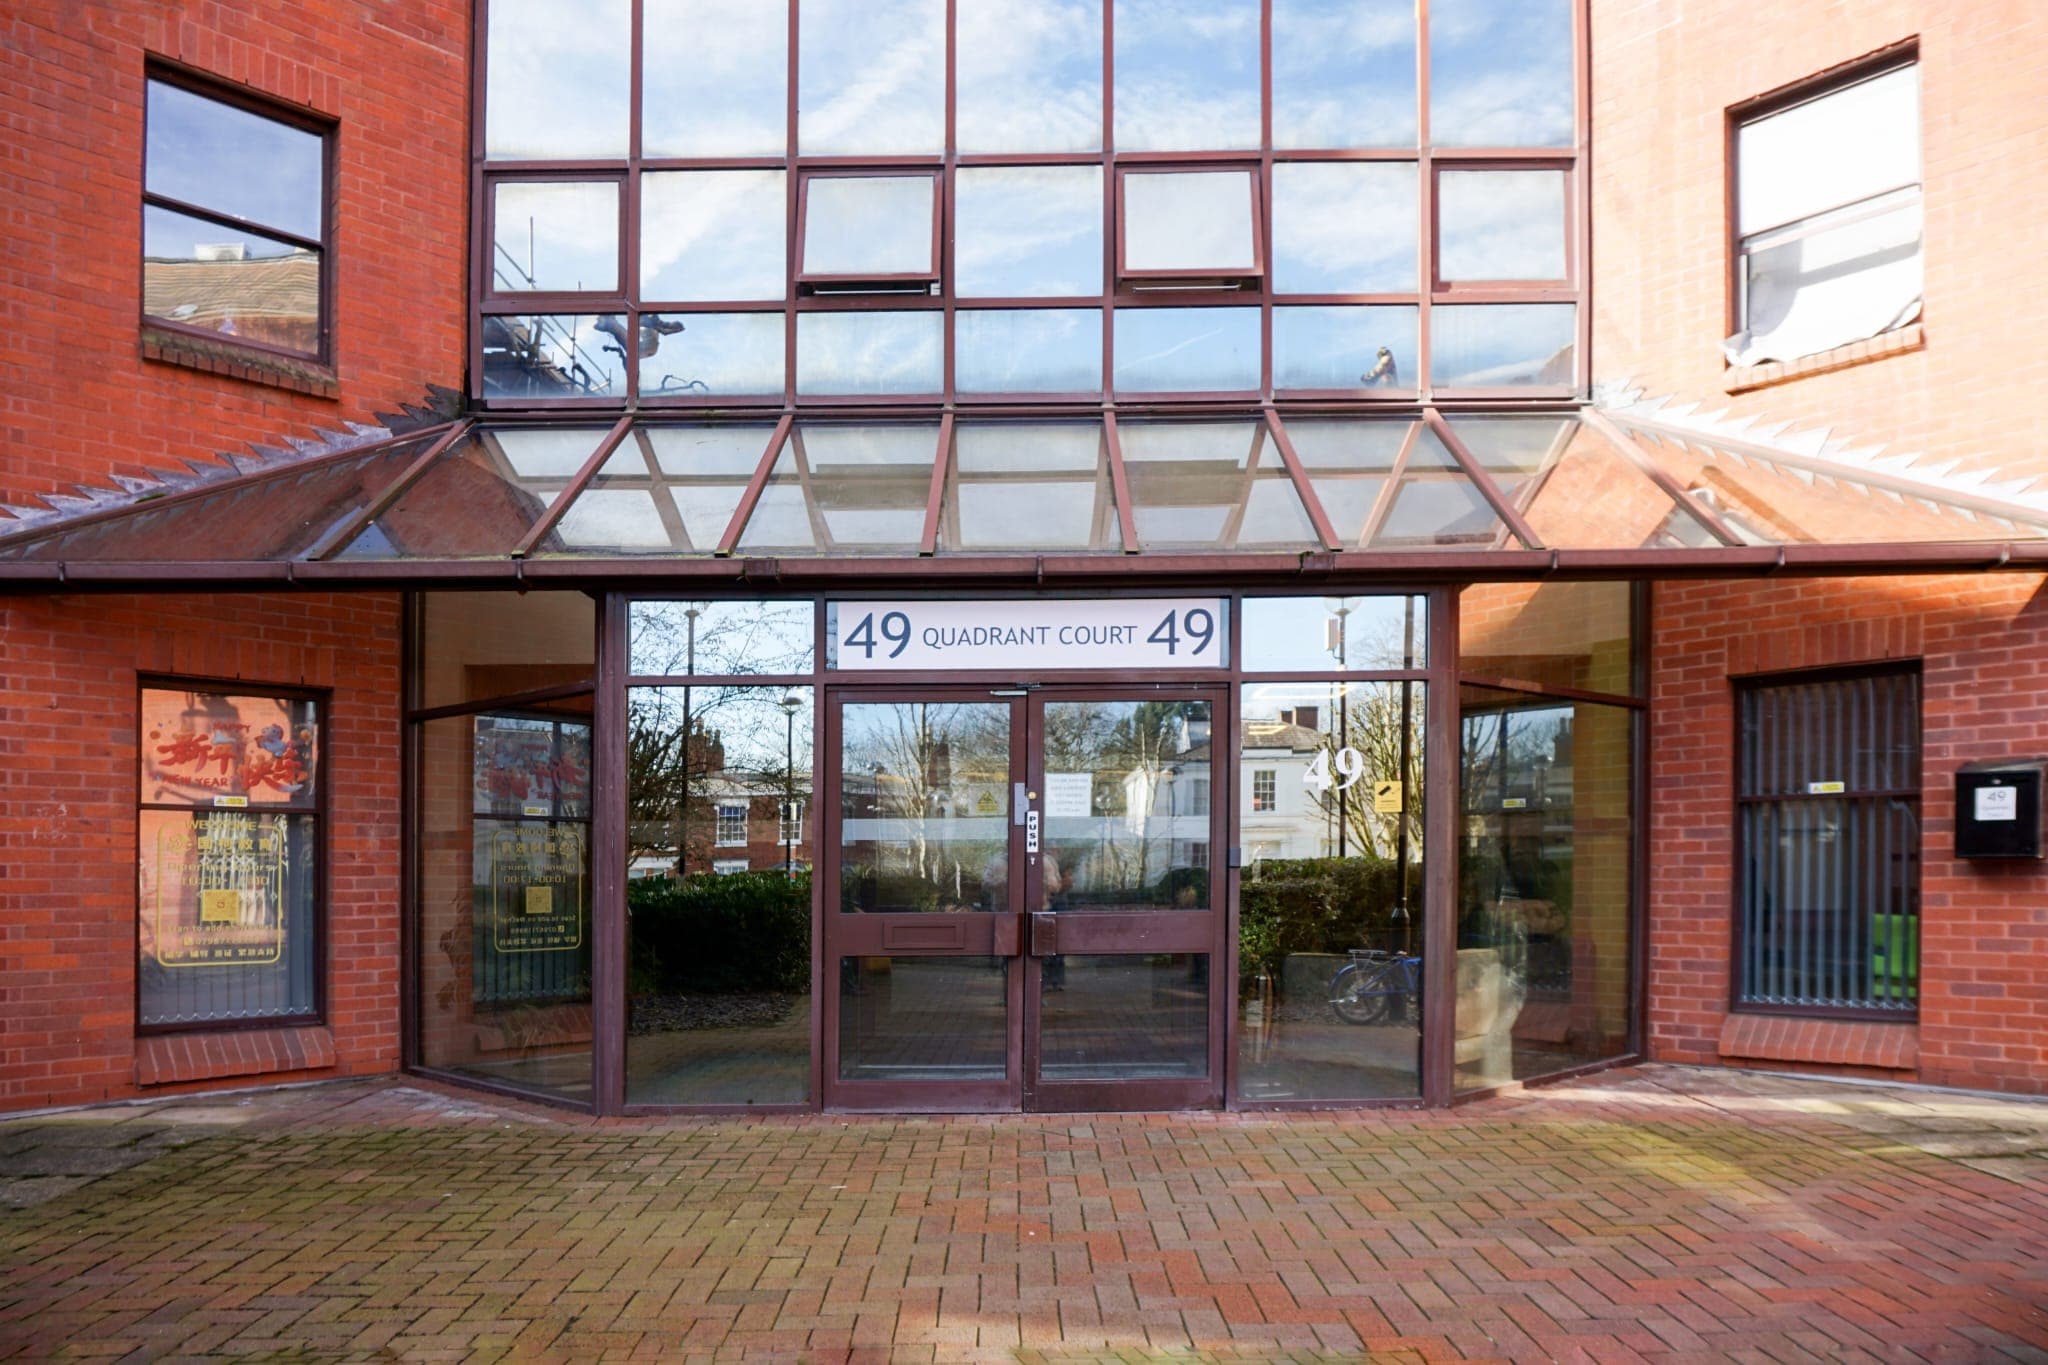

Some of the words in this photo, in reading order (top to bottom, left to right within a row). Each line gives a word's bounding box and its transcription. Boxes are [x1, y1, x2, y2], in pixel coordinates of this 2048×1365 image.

[843, 611, 911, 659] 49
[923, 625, 1051, 649] QUADRANT
[1059, 625, 1138, 645] COURT
[1147, 608, 1214, 655] 49
[1303, 747, 1363, 790] 49
[1028, 816, 1037, 848] PUSH
